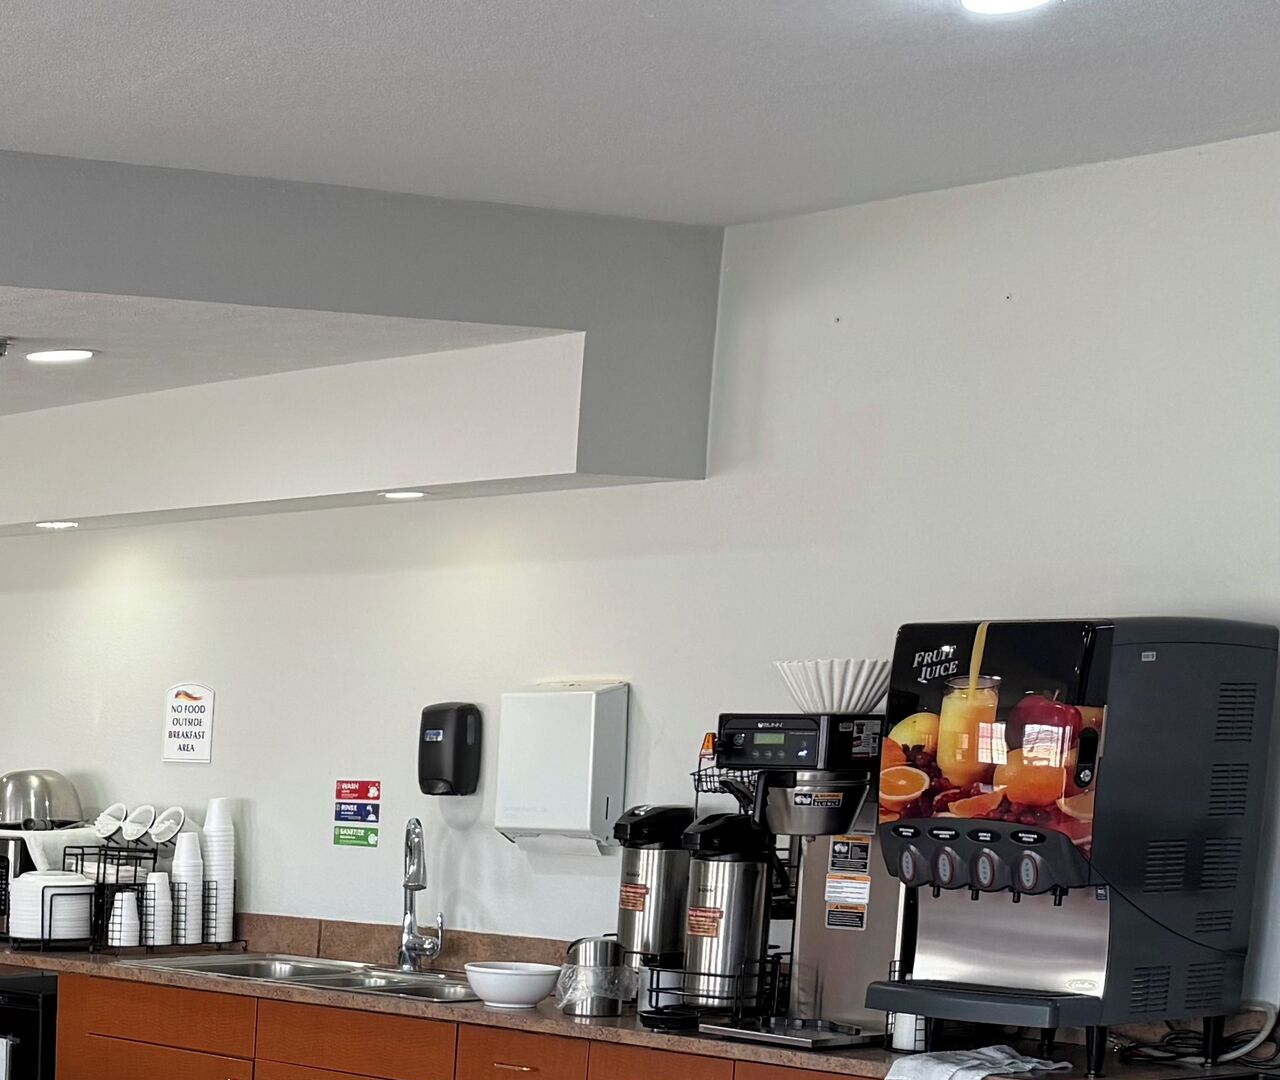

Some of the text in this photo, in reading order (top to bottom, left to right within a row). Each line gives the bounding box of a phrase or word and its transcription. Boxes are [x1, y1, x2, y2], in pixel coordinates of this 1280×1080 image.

[917, 660, 959, 683] JUICE
[171, 705, 206, 714] NO FOOD
[172, 718, 203, 727] OUTSIDE
[168, 730, 206, 740] BREAKFAST
[177, 743, 195, 752] AREA
